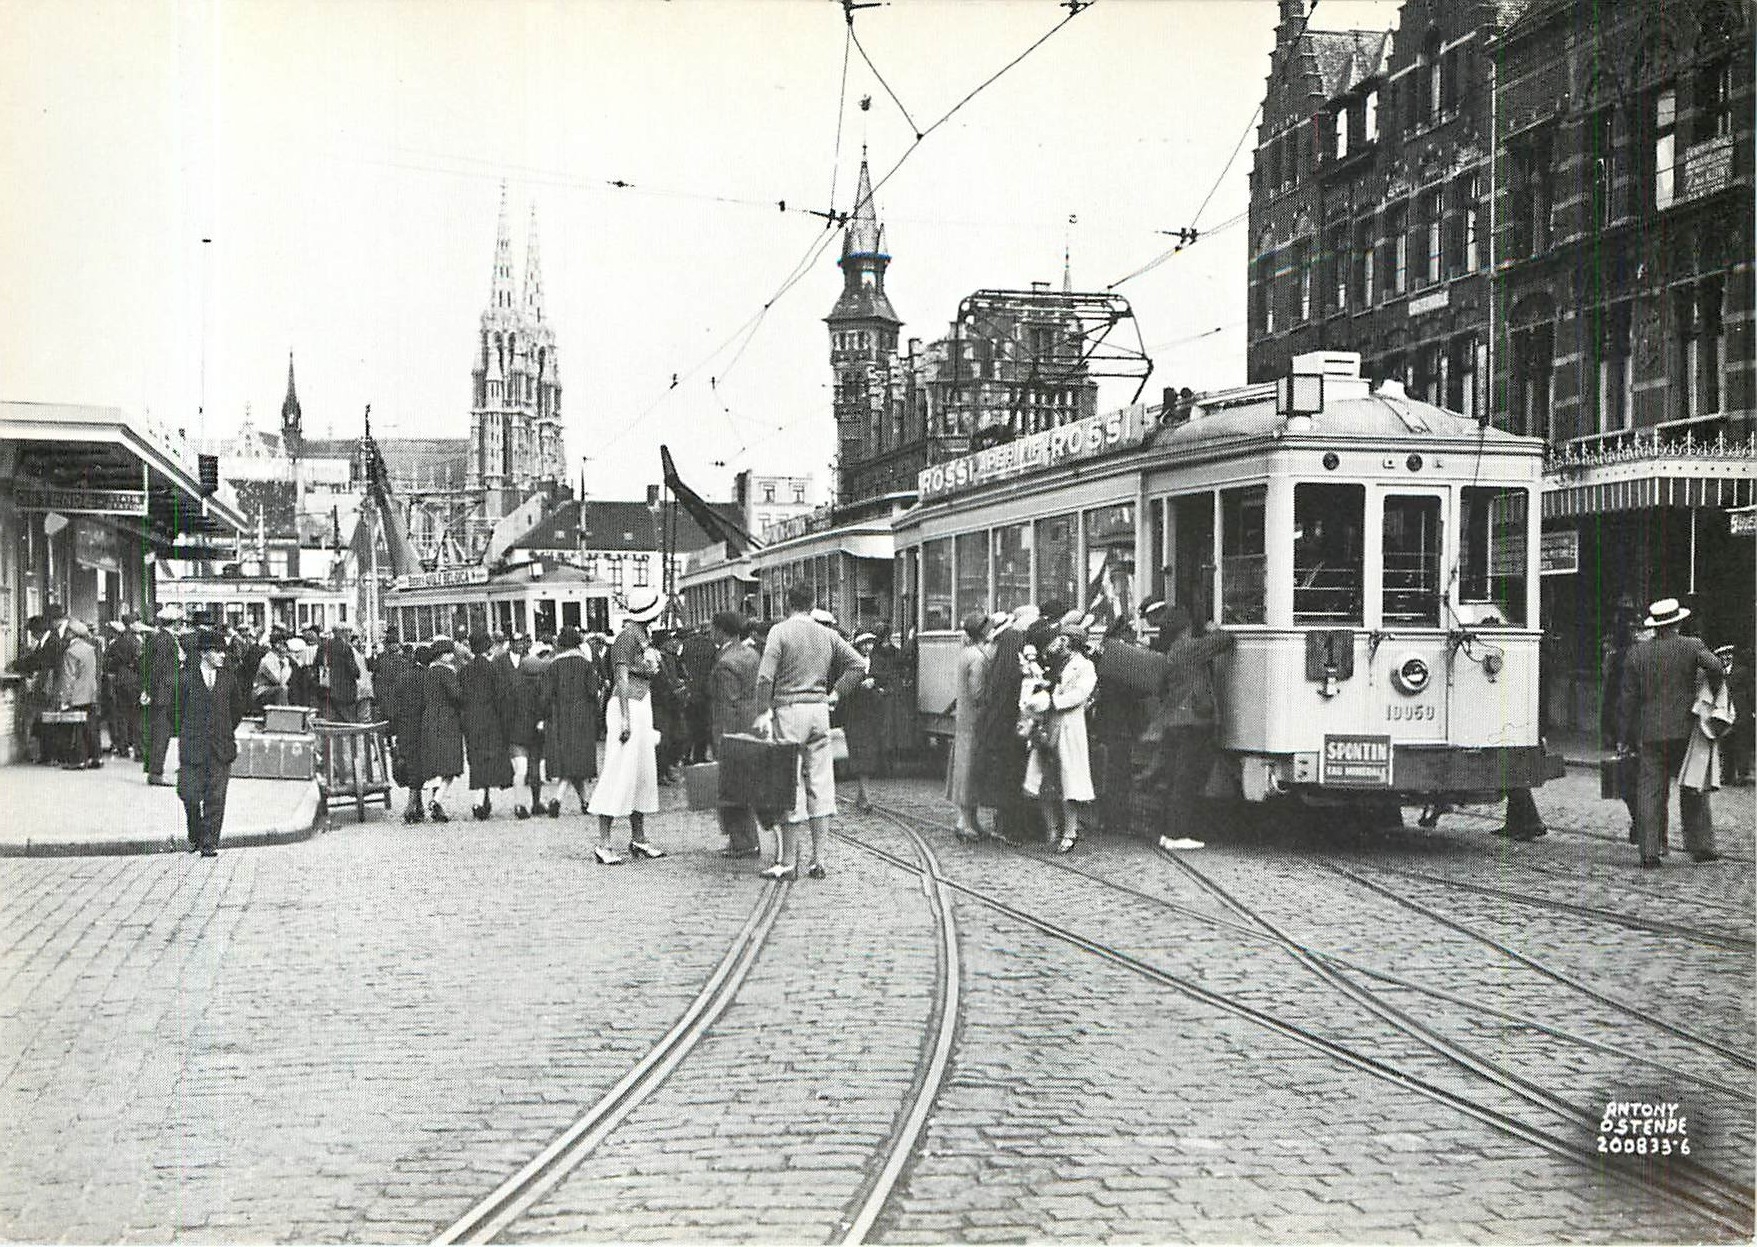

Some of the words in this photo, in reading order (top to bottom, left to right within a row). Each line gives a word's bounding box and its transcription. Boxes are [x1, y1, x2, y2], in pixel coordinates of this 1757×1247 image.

[921, 459, 974, 494] ROSSI
[1051, 410, 1133, 458] ROSSI
[1327, 741, 1387, 760] SPONTIN
